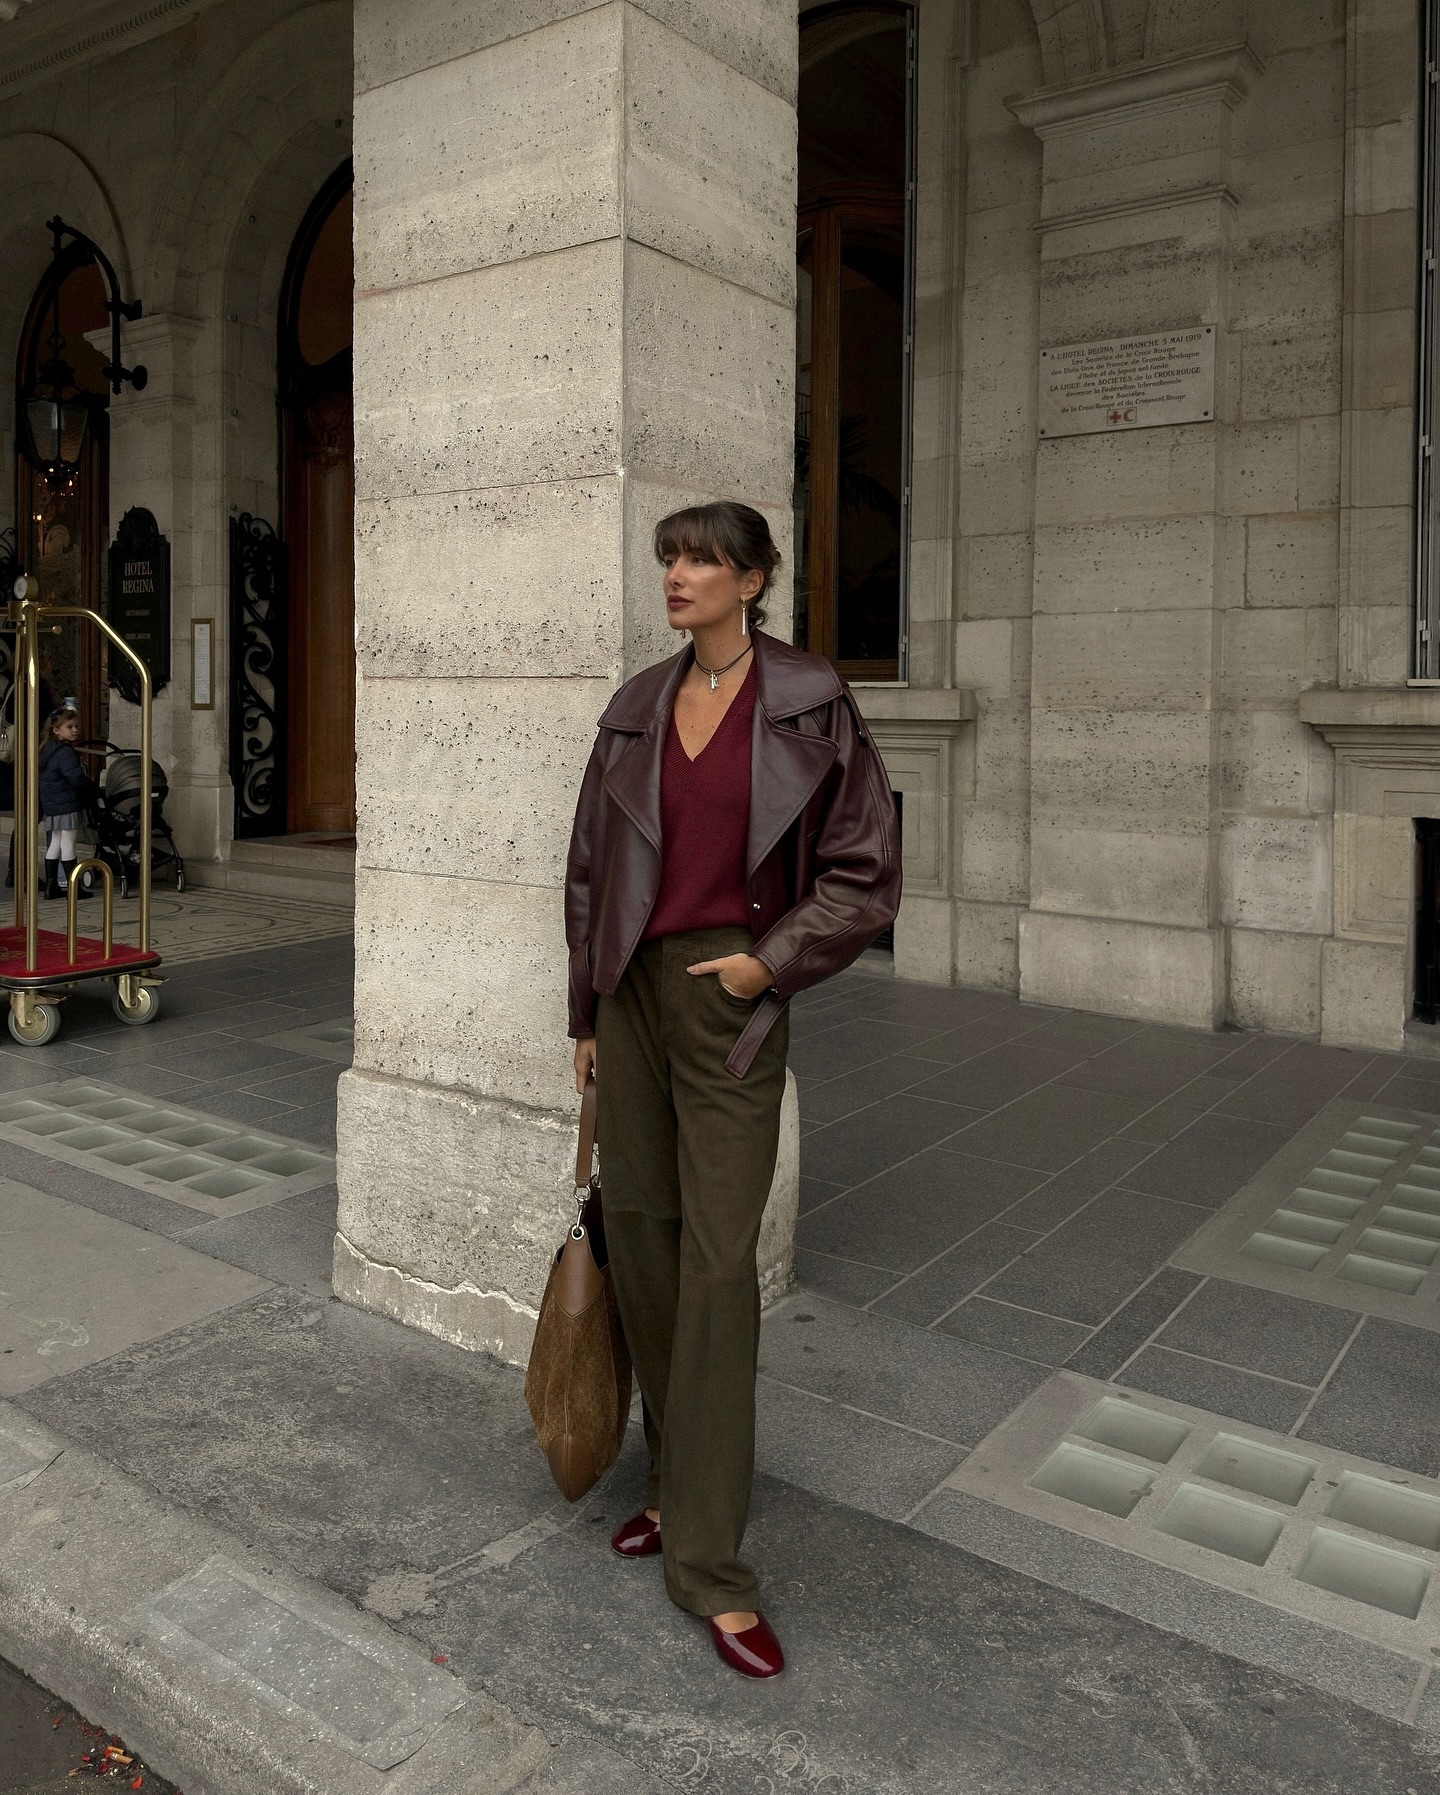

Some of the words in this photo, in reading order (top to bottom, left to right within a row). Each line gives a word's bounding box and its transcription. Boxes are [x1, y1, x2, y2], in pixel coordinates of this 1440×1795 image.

[1057, 350, 1086, 359] L'HOTEL
[1088, 346, 1114, 355] REGINA
[1120, 340, 1159, 350] DIMANCHE
[1170, 336, 1183, 344] MAI
[1185, 333, 1202, 342] 1919
[1118, 368, 1136, 376] Japon
[1060, 382, 1081, 391] LIGUE
[1137, 378, 1182, 388] Internationale
[122, 579, 154, 594] REGINA
